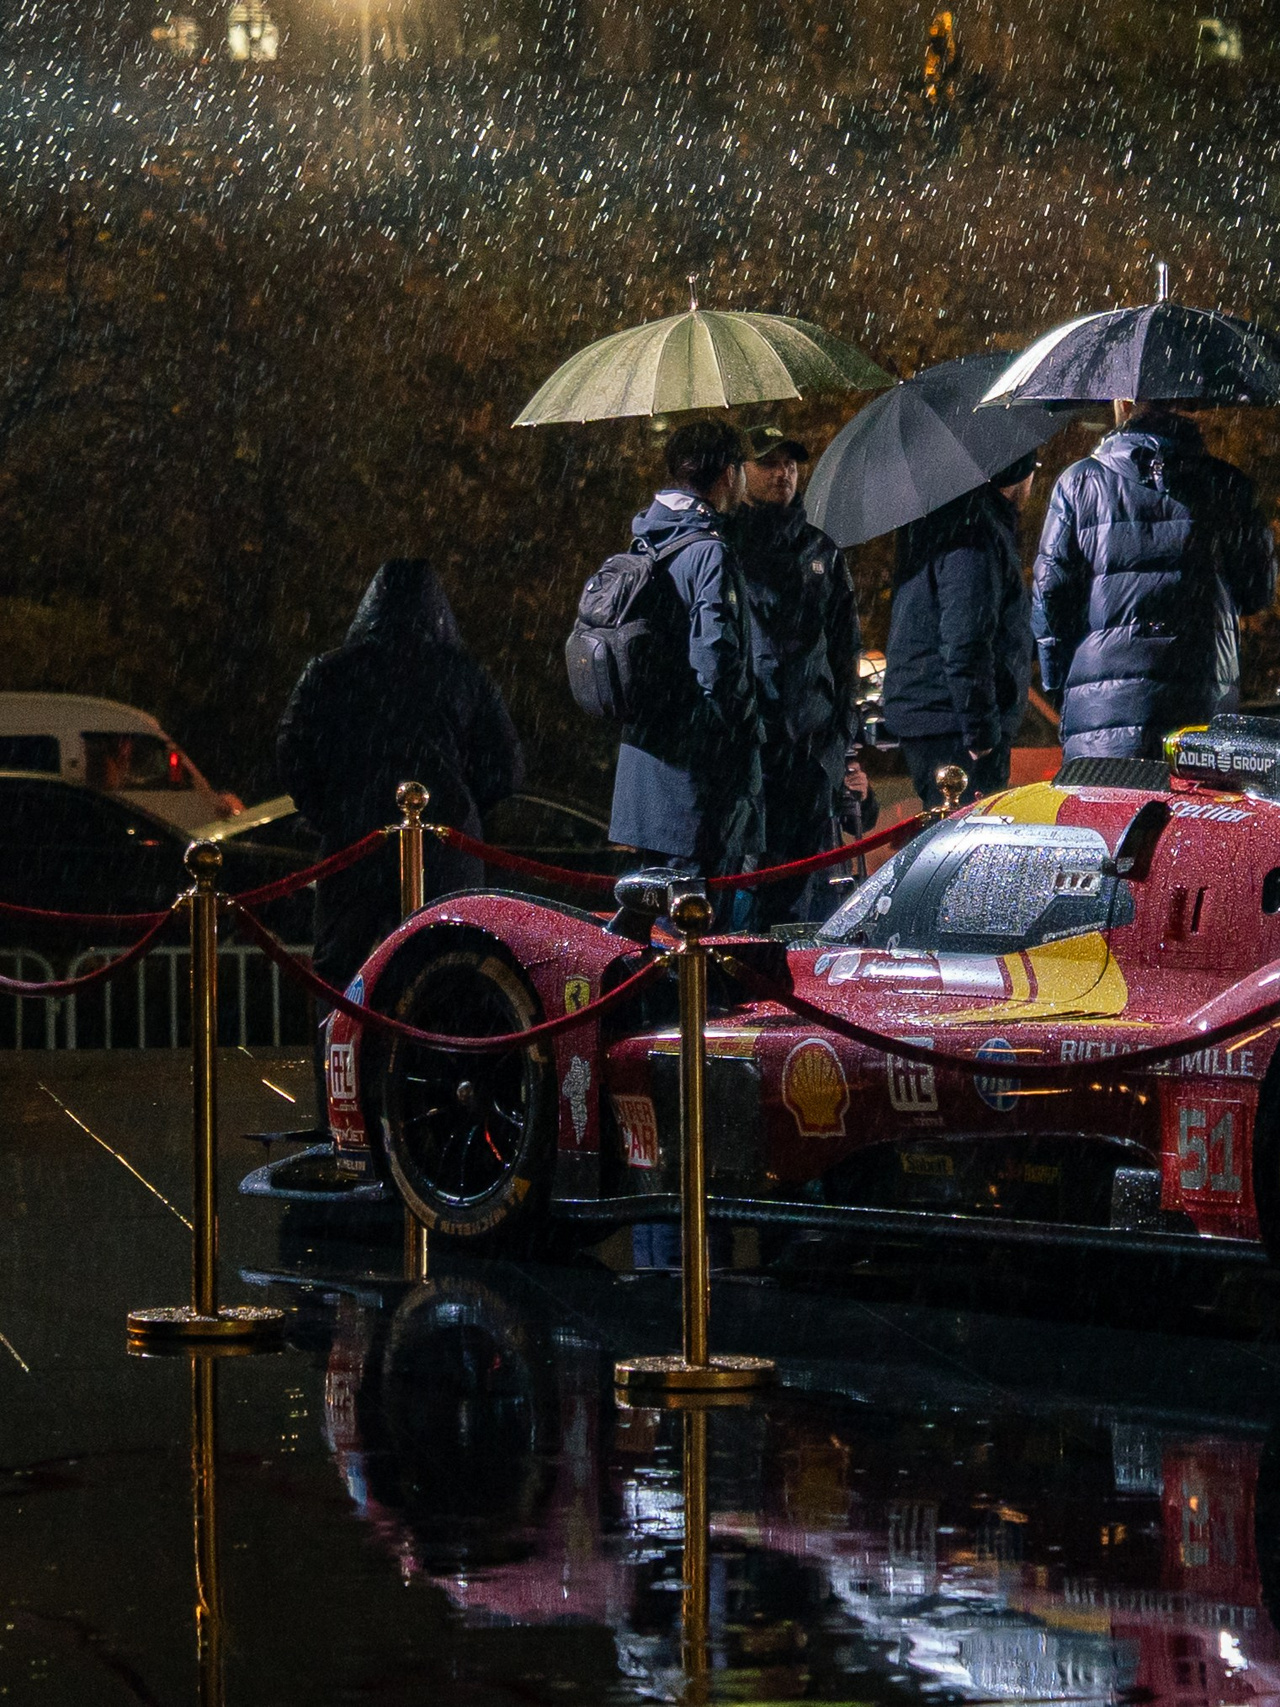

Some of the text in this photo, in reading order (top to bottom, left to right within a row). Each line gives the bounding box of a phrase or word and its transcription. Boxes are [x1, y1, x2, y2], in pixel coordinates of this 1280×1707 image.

[1178, 752, 1273, 773] ADLER GROUP
[1180, 1048, 1253, 1076] MILLE
[1179, 1107, 1242, 1192] 51
